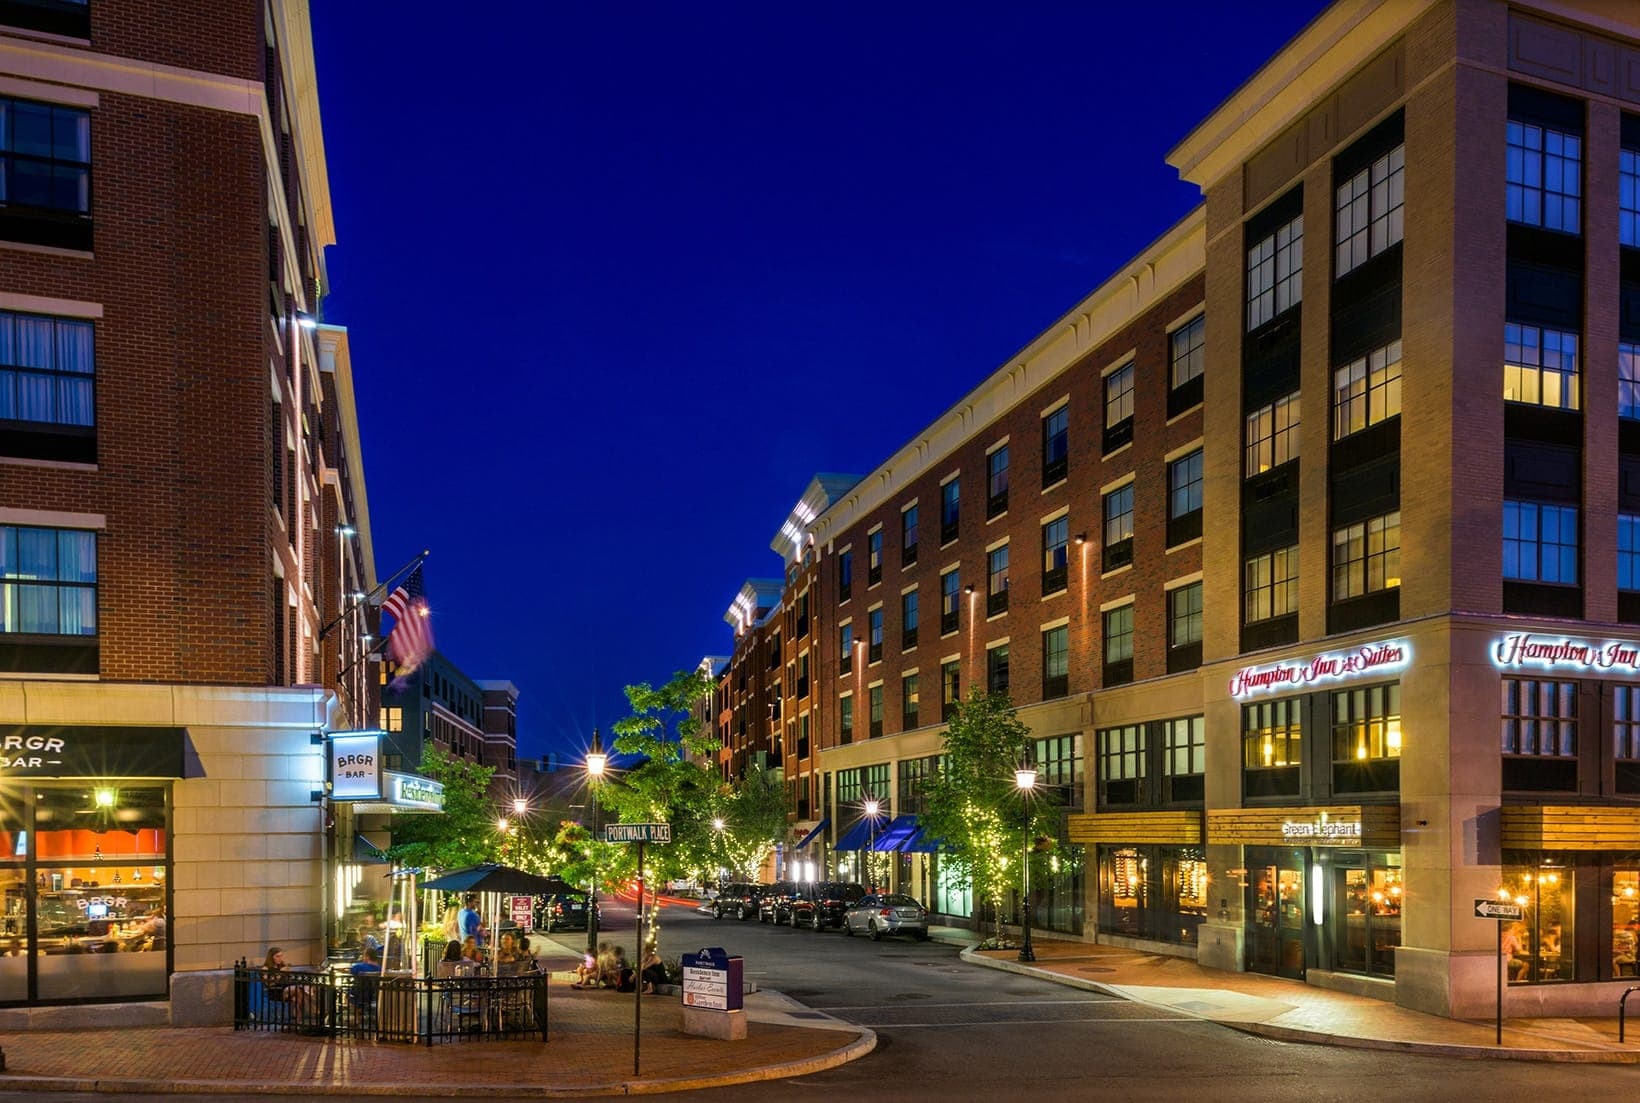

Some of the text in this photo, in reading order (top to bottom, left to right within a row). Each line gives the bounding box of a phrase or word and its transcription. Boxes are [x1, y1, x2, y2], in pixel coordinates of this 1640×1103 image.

[1496, 634, 1640, 668] Hampton Inn
[1228, 665, 1300, 697] Hampton
[1300, 655, 1344, 681] Inn
[1352, 646, 1403, 671] Suites
[0, 735, 65, 753] RGR
[0, 757, 42, 768] BAR
[338, 754, 374, 768] BRGR
[345, 770, 365, 779] BAR
[608, 826, 669, 840] PORTWALK PLACE
[1282, 814, 1360, 838] Green Elephant
[76, 895, 128, 910] BRGR
[1487, 905, 1519, 915] ONE WAY
